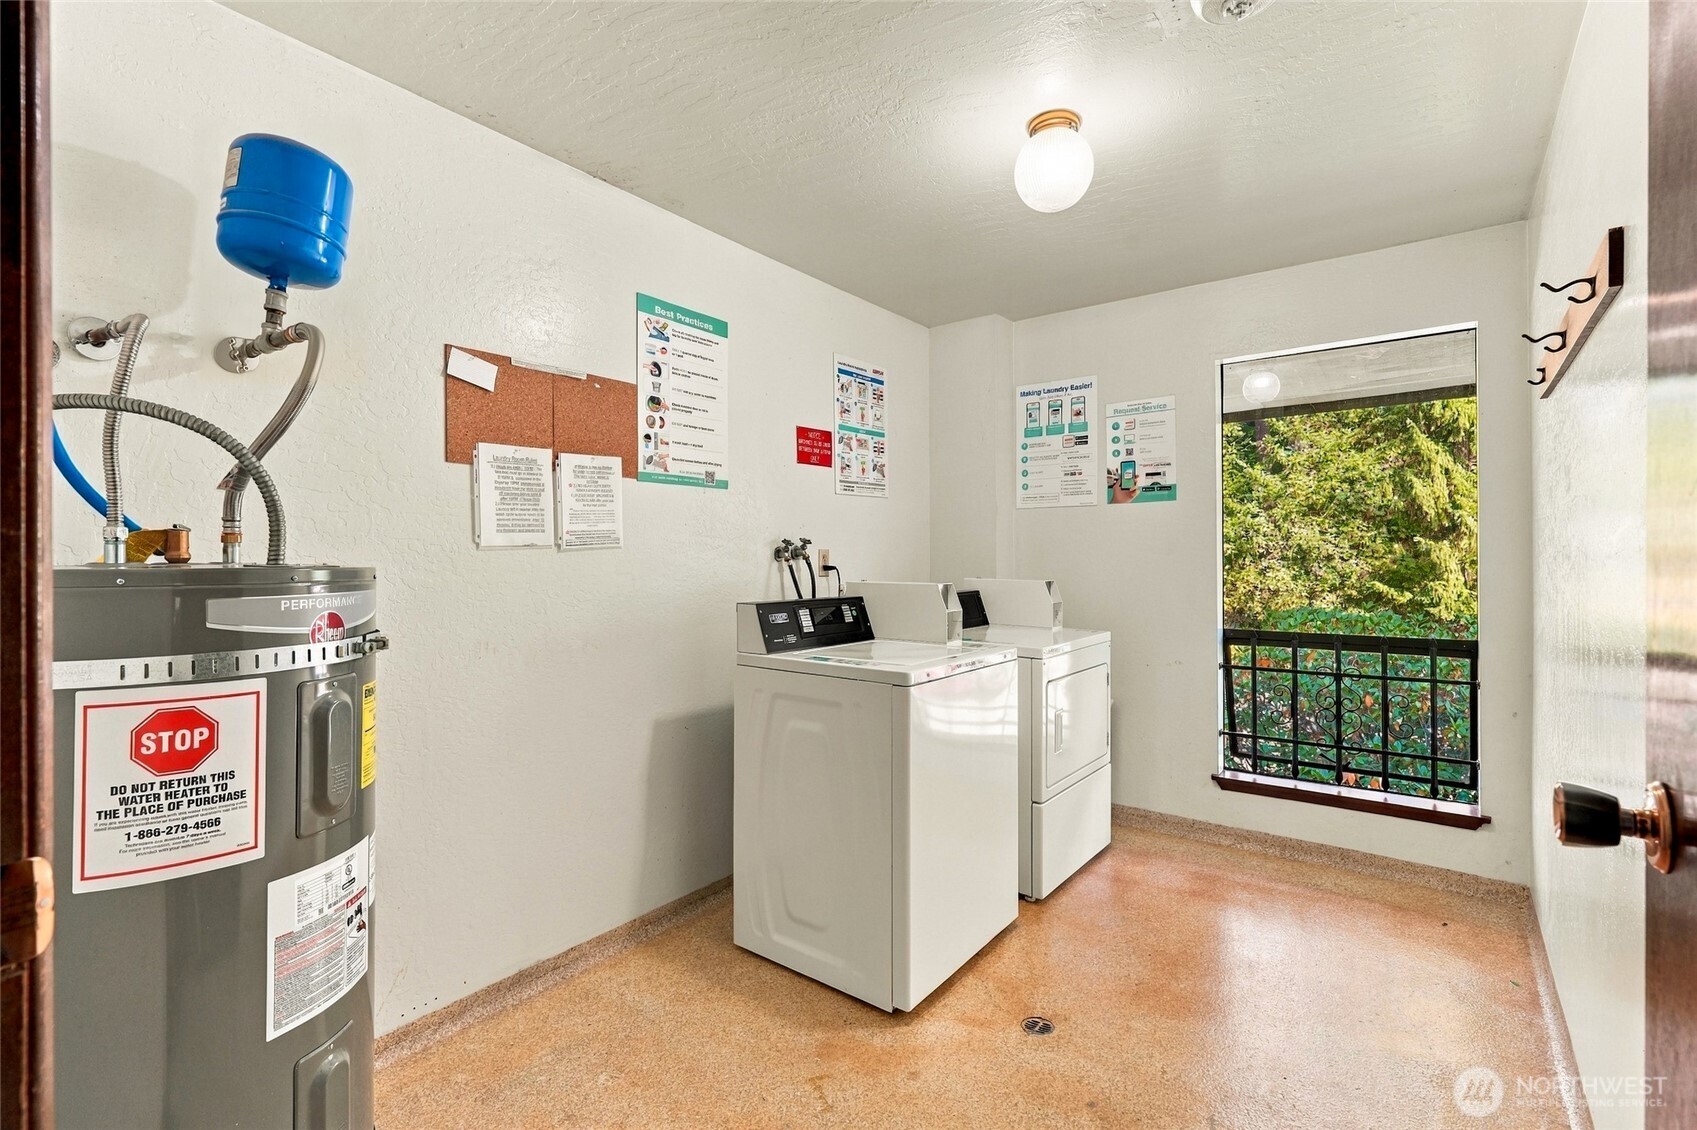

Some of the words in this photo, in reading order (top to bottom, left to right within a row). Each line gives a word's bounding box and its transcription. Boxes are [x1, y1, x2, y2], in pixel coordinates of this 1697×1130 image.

[655, 305, 674, 319] Best
[677, 313, 713, 332] Practices
[1043, 386, 1069, 394] Laundry
[1071, 382, 1092, 391] Easier!
[1114, 407, 1140, 415] Request
[315, 613, 344, 642] Rheem
[140, 727, 210, 756] STOP
[110, 785, 127, 796] DO
[131, 782, 155, 794] NOT
[160, 774, 206, 790] RETURN
[210, 771, 236, 783] THIS
[118, 793, 161, 807] WATER
[165, 784, 210, 800] HEATER
[213, 782, 228, 792] TO
[96, 809, 120, 821] THE
[124, 804, 165, 818] PLACE
[167, 800, 183, 812] OF
[187, 789, 246, 808] PURCHASE
[125, 817, 221, 842] 1-866-279-4566
[136, 849, 157, 857] provided
